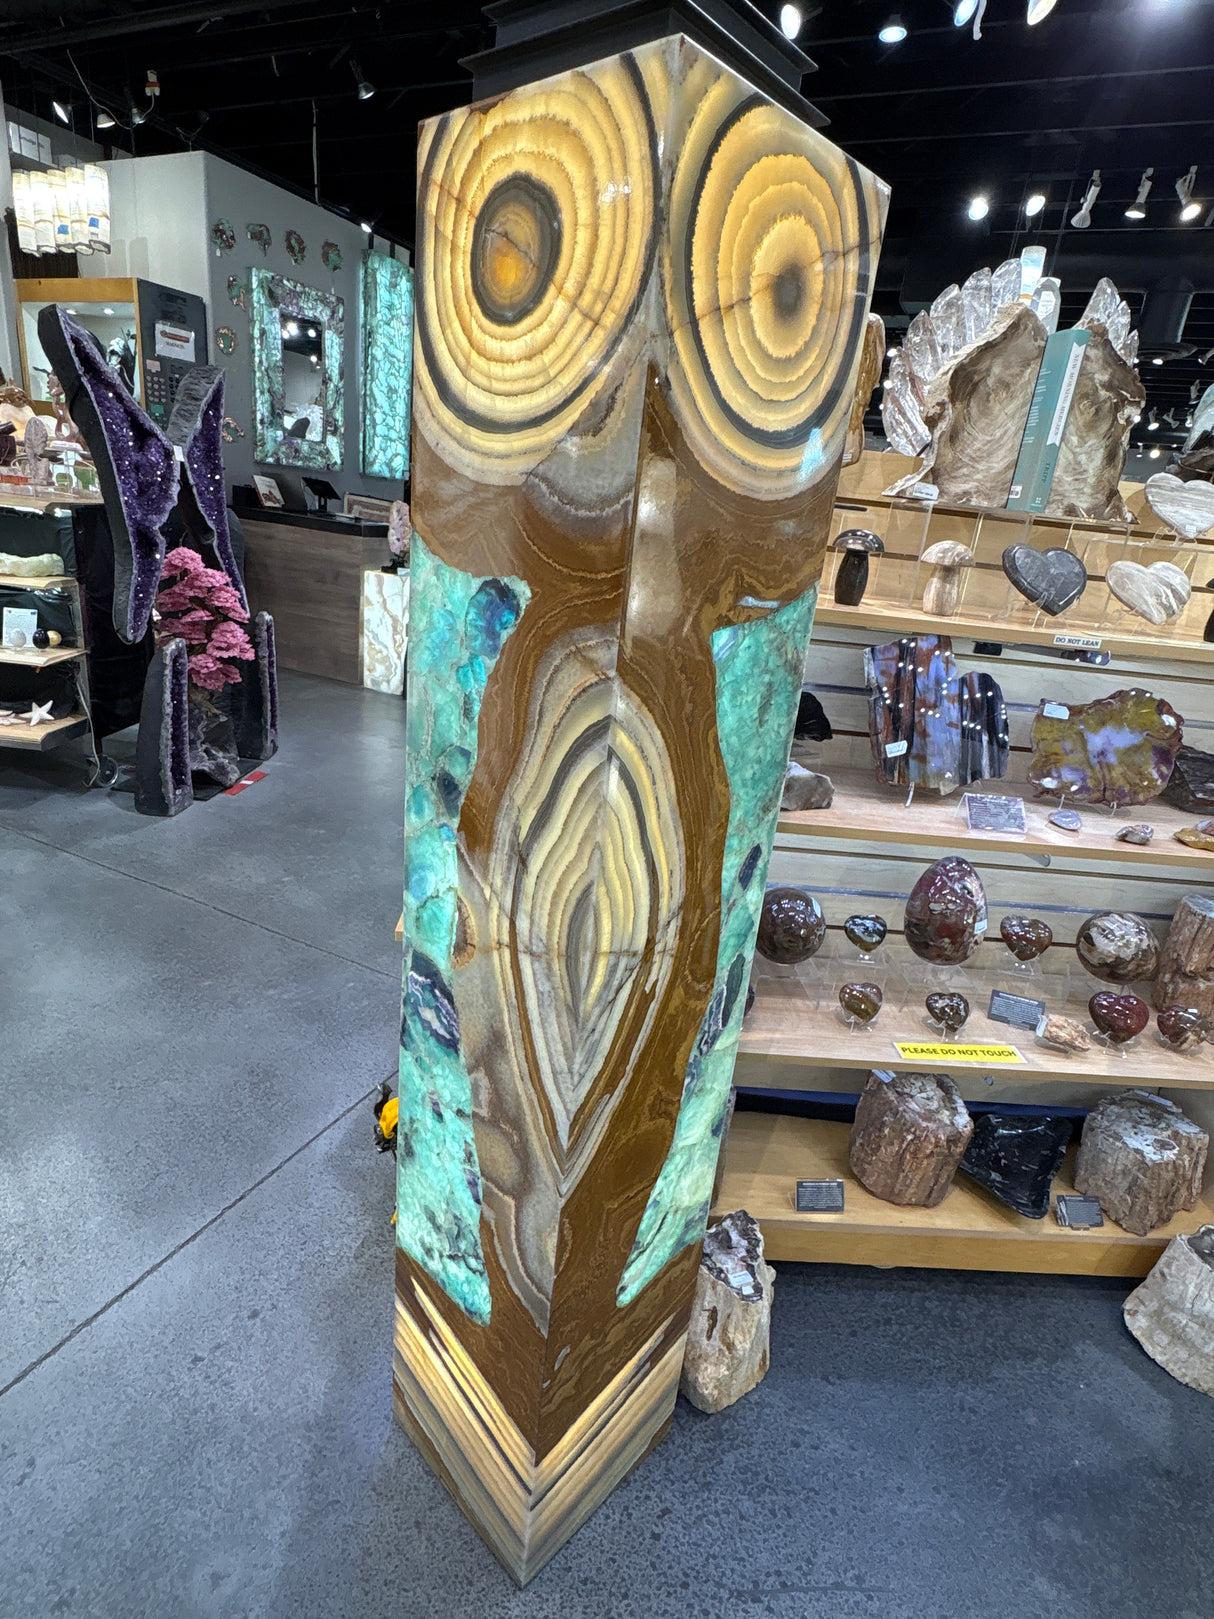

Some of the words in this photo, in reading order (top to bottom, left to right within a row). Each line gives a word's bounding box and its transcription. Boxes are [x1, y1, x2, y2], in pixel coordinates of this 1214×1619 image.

[1071, 353, 1080, 369] NEW
[1062, 372, 1075, 404] MORNING
[1041, 462, 1050, 482] TRIPP
[901, 1046, 940, 1055] PLEASE
[979, 1049, 1017, 1057] TOUCH
